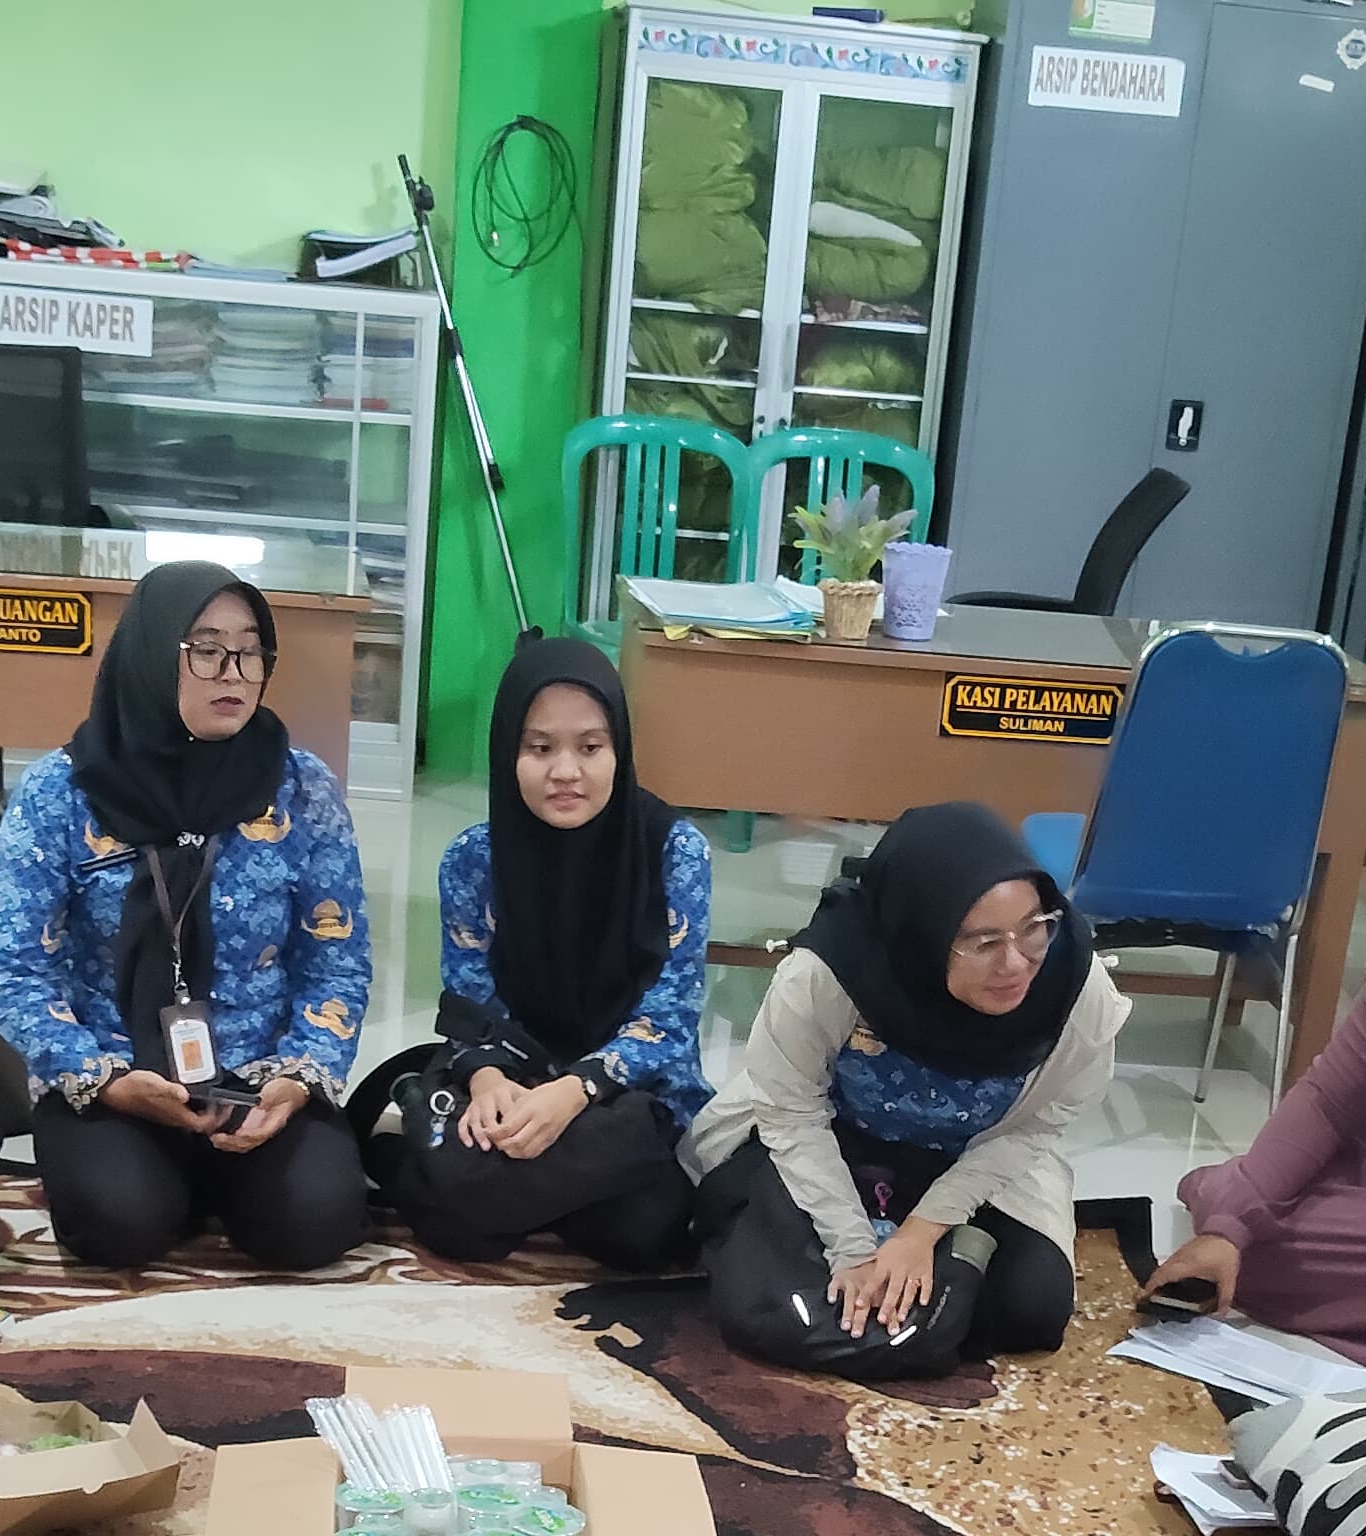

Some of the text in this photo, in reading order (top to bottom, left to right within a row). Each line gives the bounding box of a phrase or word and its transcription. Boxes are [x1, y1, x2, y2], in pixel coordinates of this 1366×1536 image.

[1035, 55, 1166, 103] ARSIP BENDAHARA
[0, 294, 59, 335] ARSIP
[66, 299, 134, 342] KAPER
[956, 684, 1114, 716] KASI PELAYANAN
[998, 716, 1066, 733] SULIMAN
